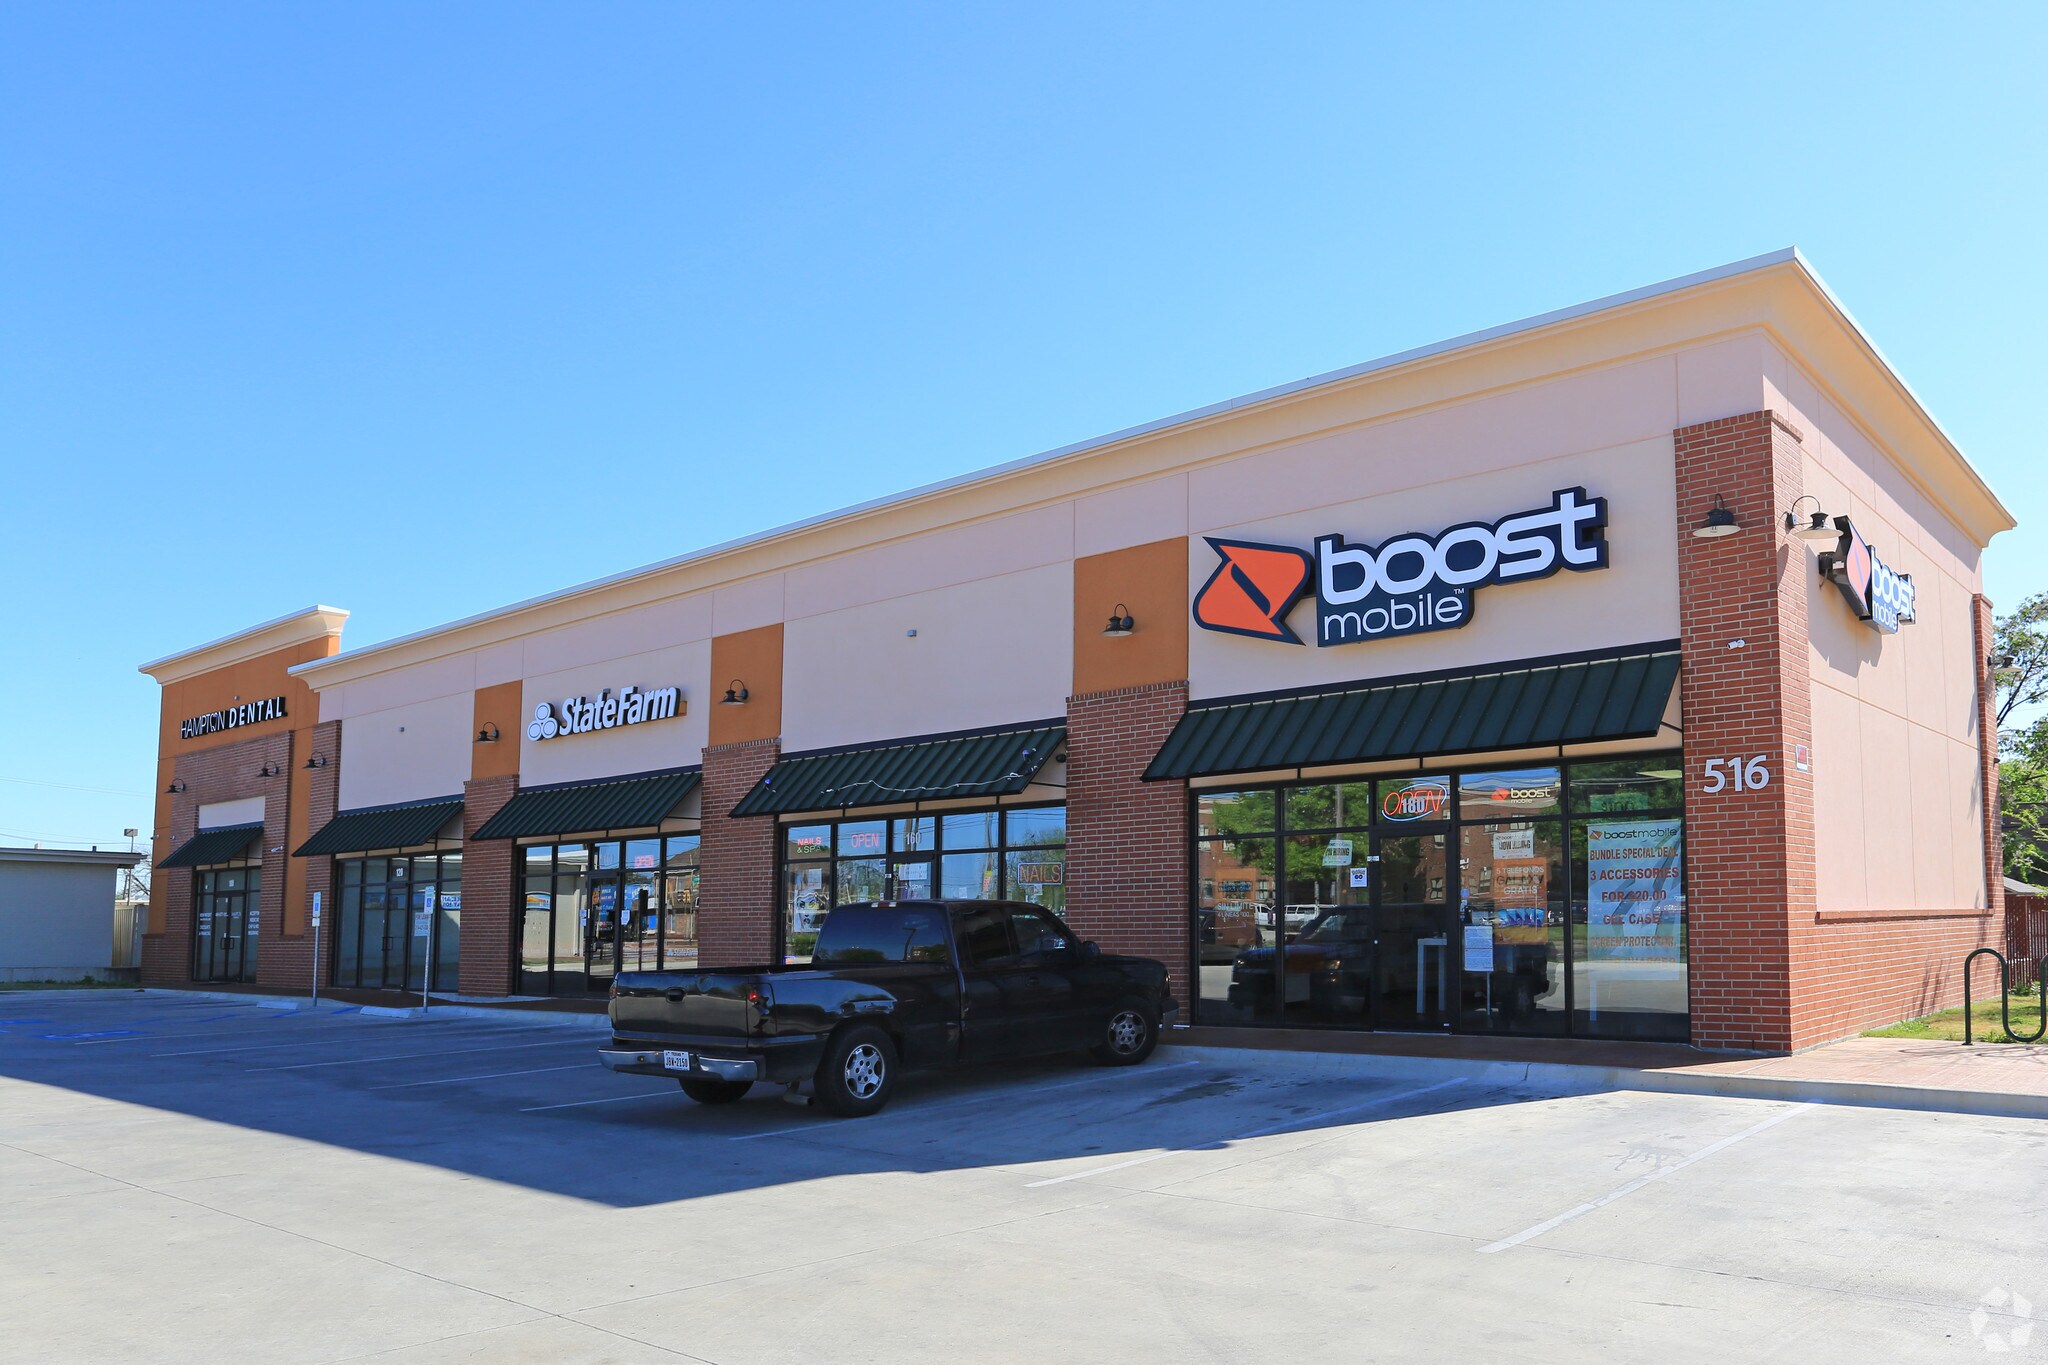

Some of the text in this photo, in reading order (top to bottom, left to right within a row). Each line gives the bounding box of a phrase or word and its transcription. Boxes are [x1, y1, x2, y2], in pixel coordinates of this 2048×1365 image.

[1319, 491, 1598, 606] boost
[1871, 545, 1914, 621] boost
[1323, 594, 1463, 641] mobile
[1872, 600, 1897, 630] mobile
[180, 696, 283, 739] HAMPTON DENTAL
[1702, 754, 1770, 794] 516
[1510, 788, 1551, 799] boost
[1401, 796, 1426, 814] 180
[797, 836, 822, 846] NAILS
[851, 833, 879, 849] OPEN
[905, 832, 922, 845] 160
[803, 845, 821, 854] SPA
[1590, 846, 1679, 861] BUNDLE SPECIAL DEAL
[1019, 864, 1061, 883] NAILS
[1590, 867, 1680, 881] 3 ACCESSORIES
[1601, 889, 1668, 903] FOR $20.00
